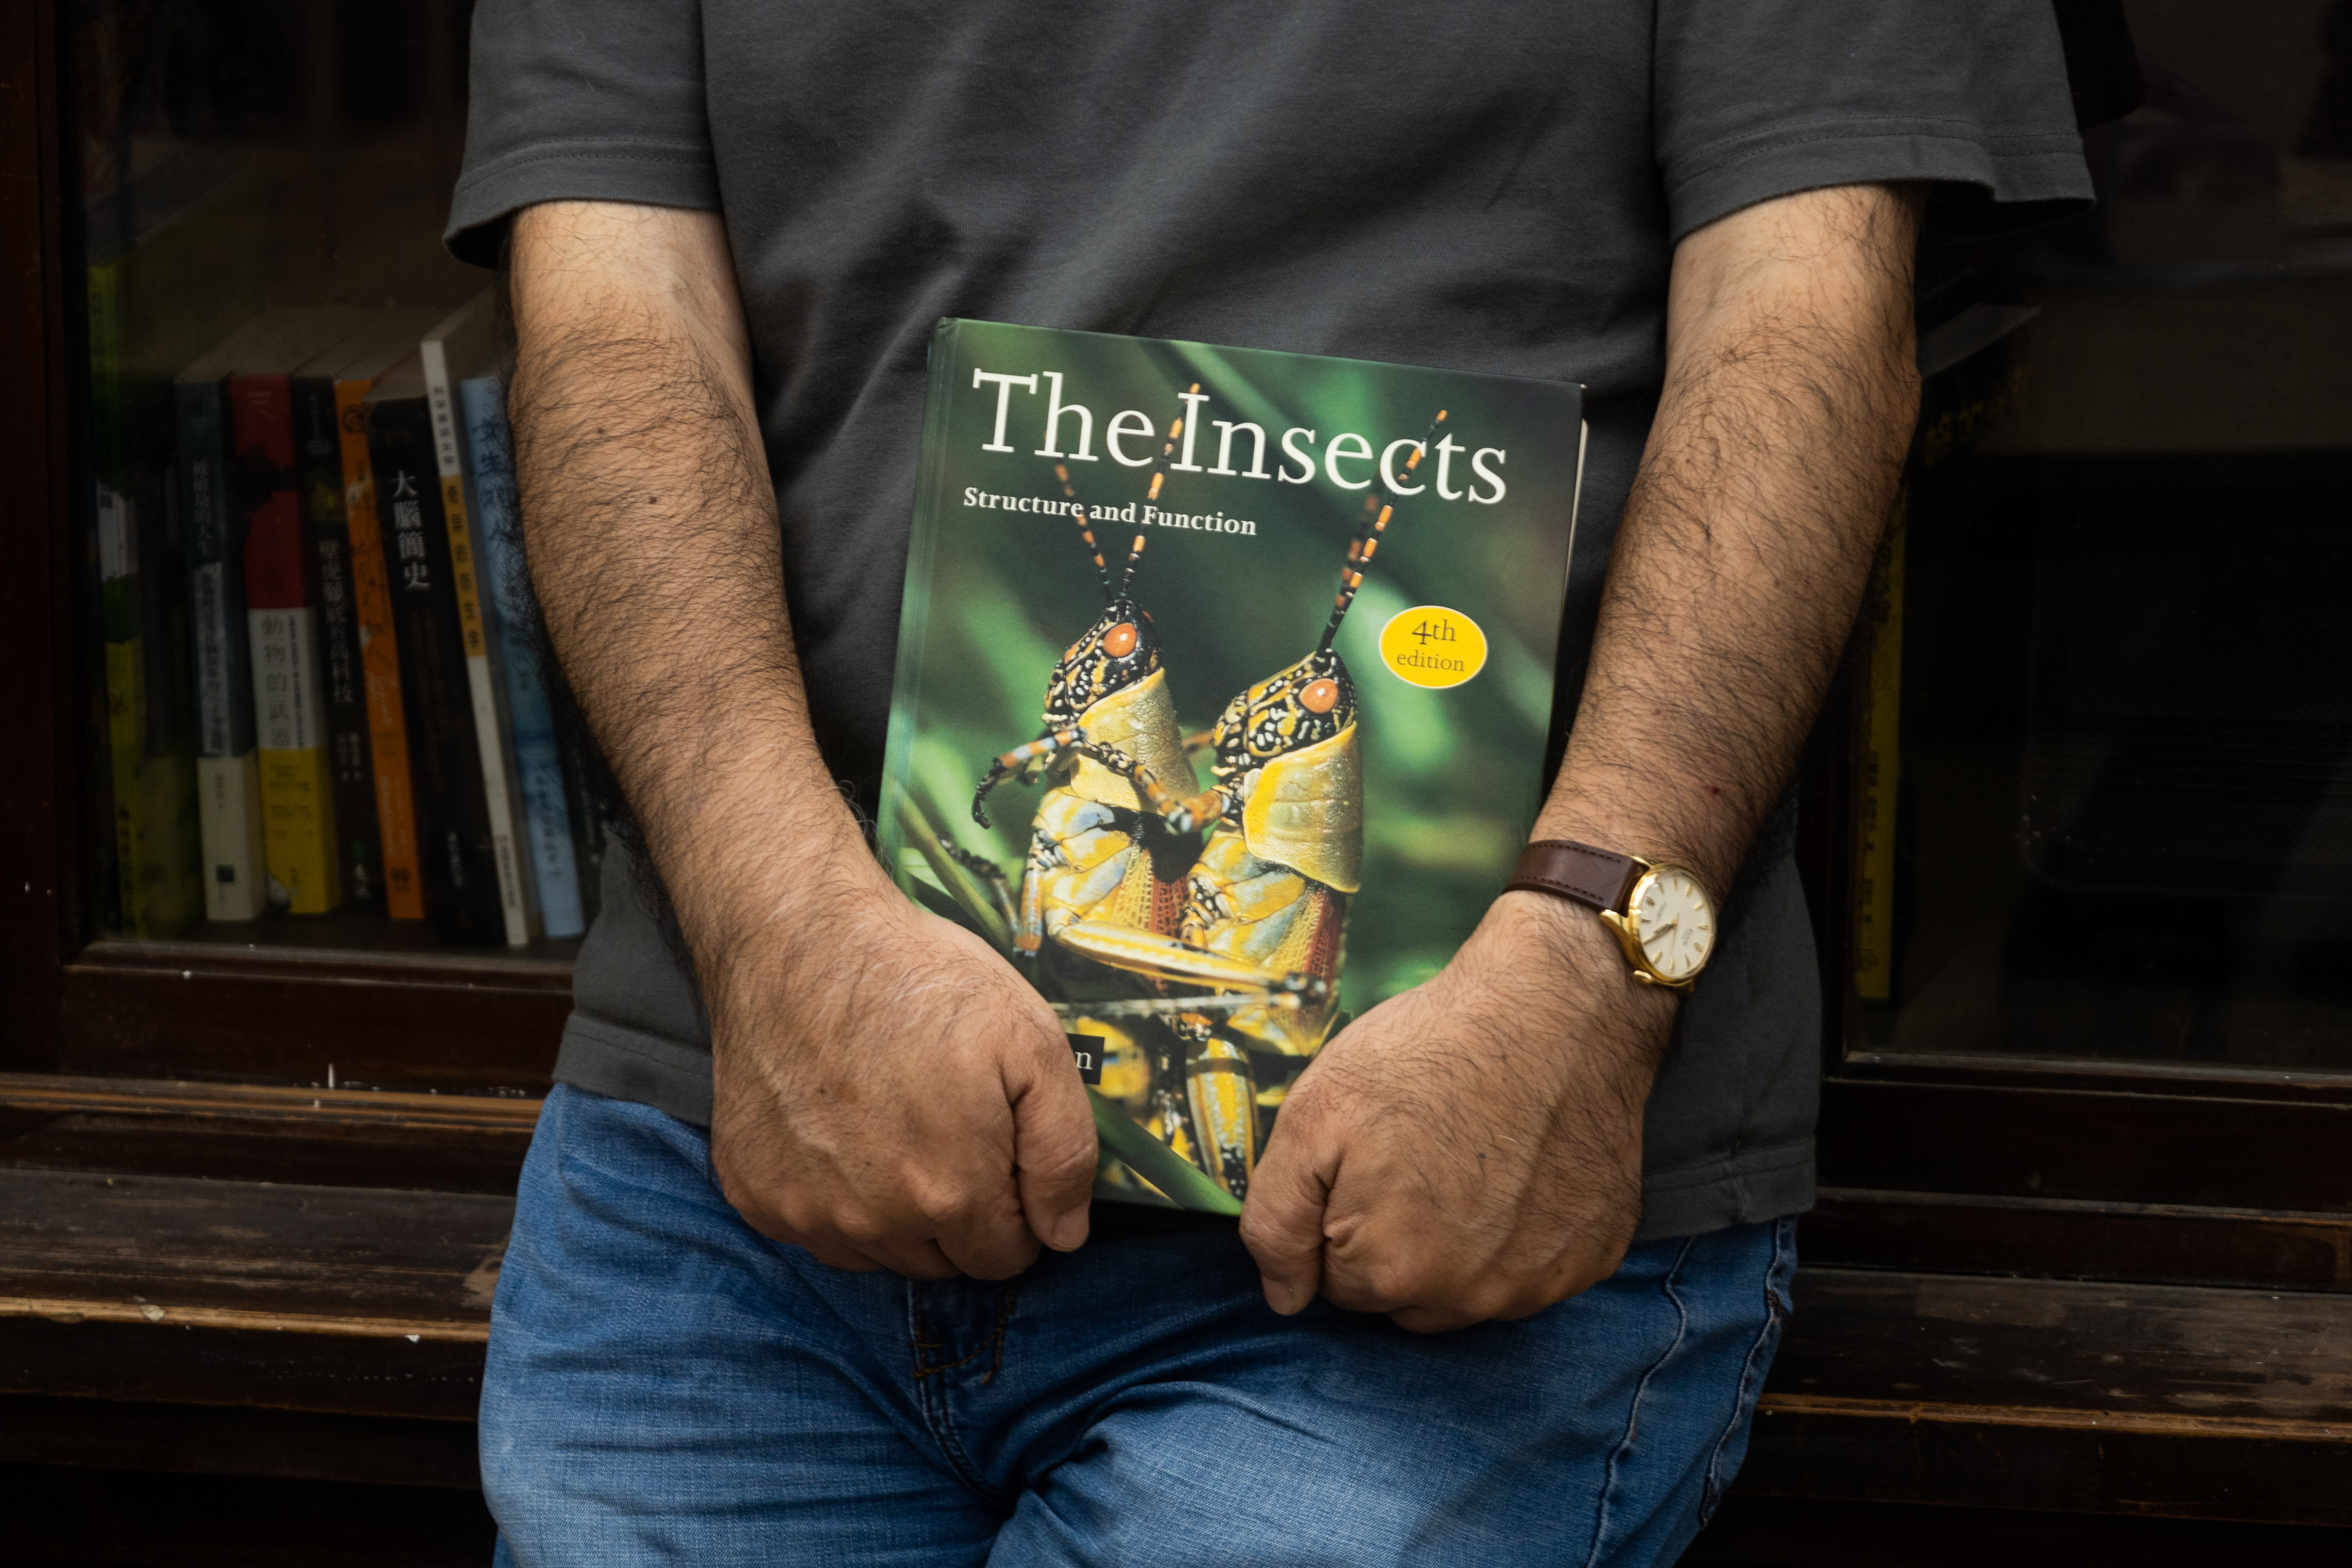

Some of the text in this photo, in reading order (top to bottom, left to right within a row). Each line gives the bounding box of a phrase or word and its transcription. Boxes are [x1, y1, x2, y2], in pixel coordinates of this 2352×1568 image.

[972, 367, 1507, 505] The Insects
[391, 469, 430, 590] 大腦簡史
[963, 486, 1257, 536] Structure and Function
[1411, 619, 1456, 645] 4th
[1396, 650, 1465, 671] edition
